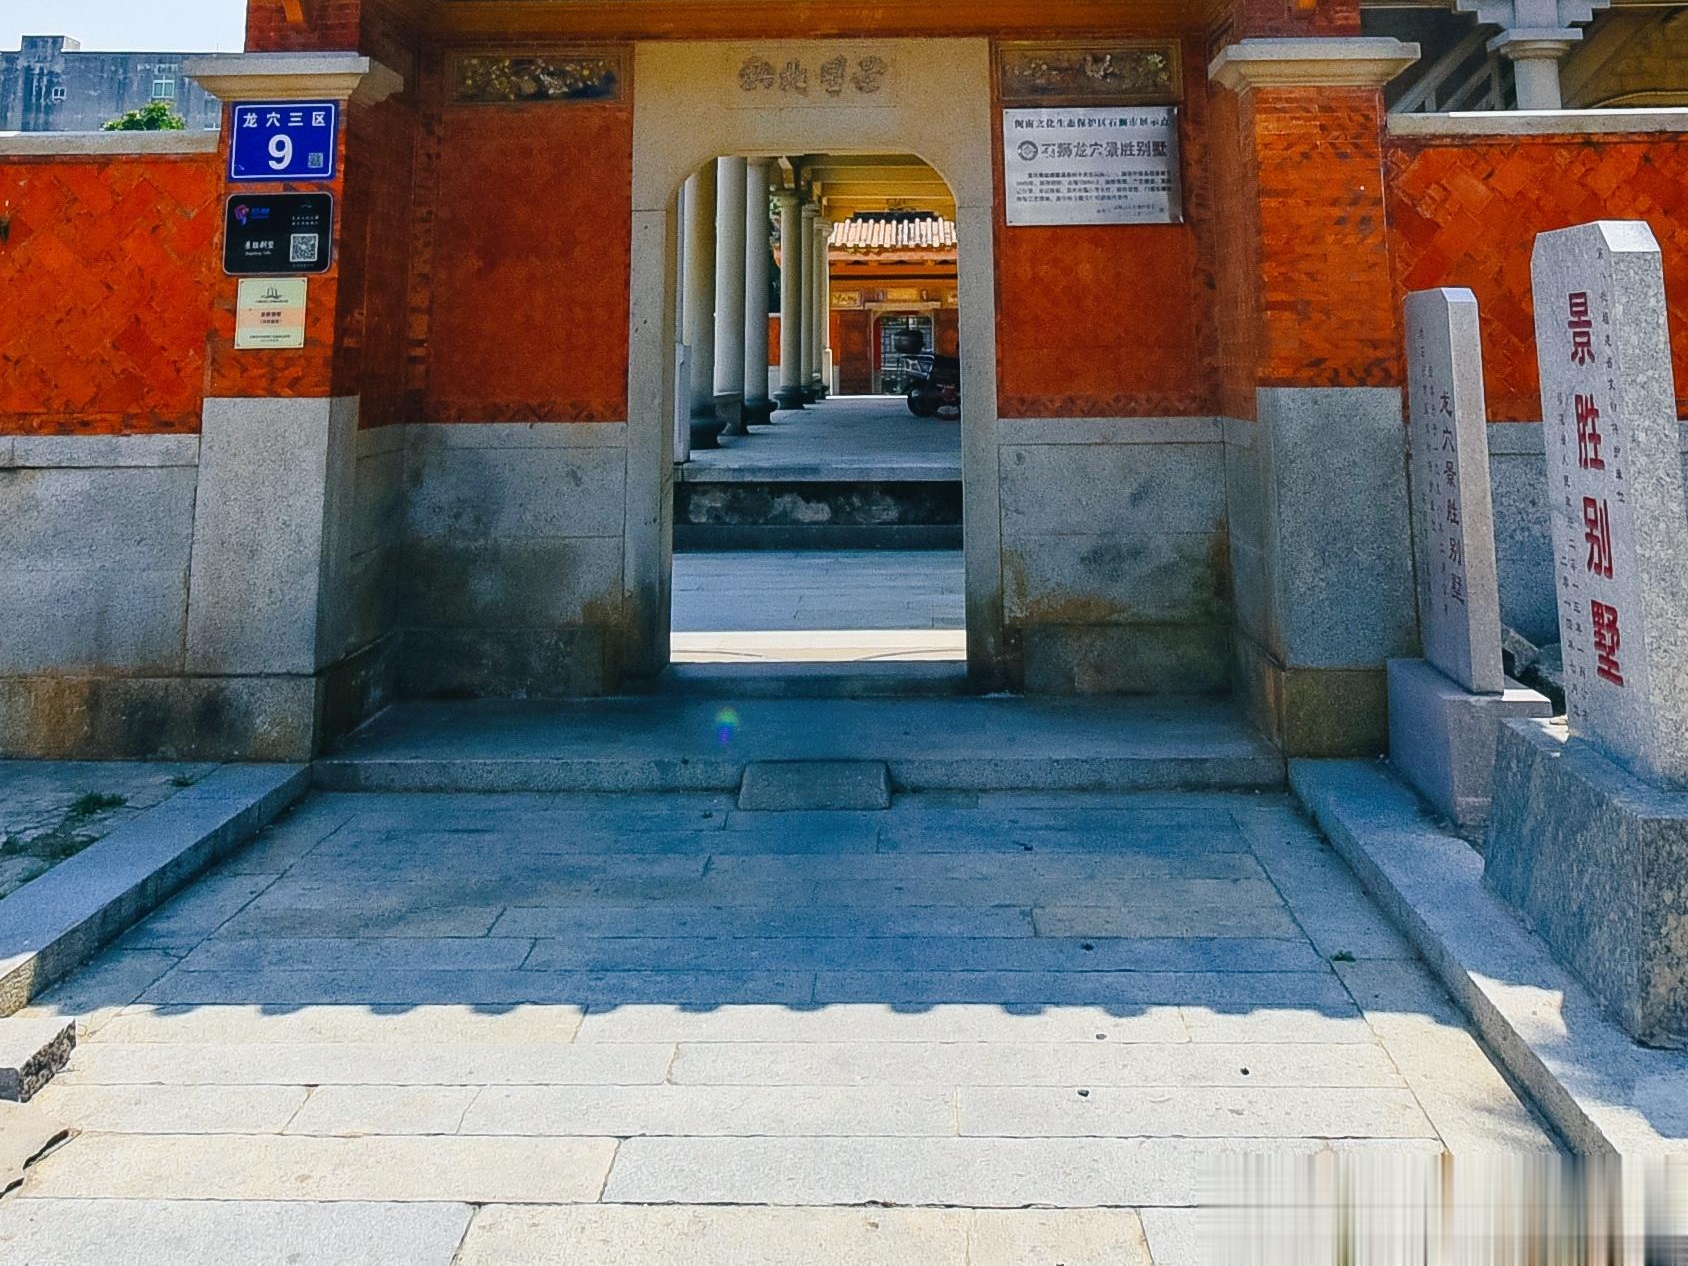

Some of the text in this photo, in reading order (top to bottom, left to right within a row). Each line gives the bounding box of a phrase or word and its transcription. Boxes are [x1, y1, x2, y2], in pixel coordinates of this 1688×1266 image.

[242, 111, 326, 128] 龙穴三区
[268, 134, 293, 171] 9
[1040, 139, 1168, 159] 石狮龙穴景胜别墅
[1439, 388, 1466, 606] 龙穴景胜别墅
[1567, 291, 1625, 689] 景胜别墅
